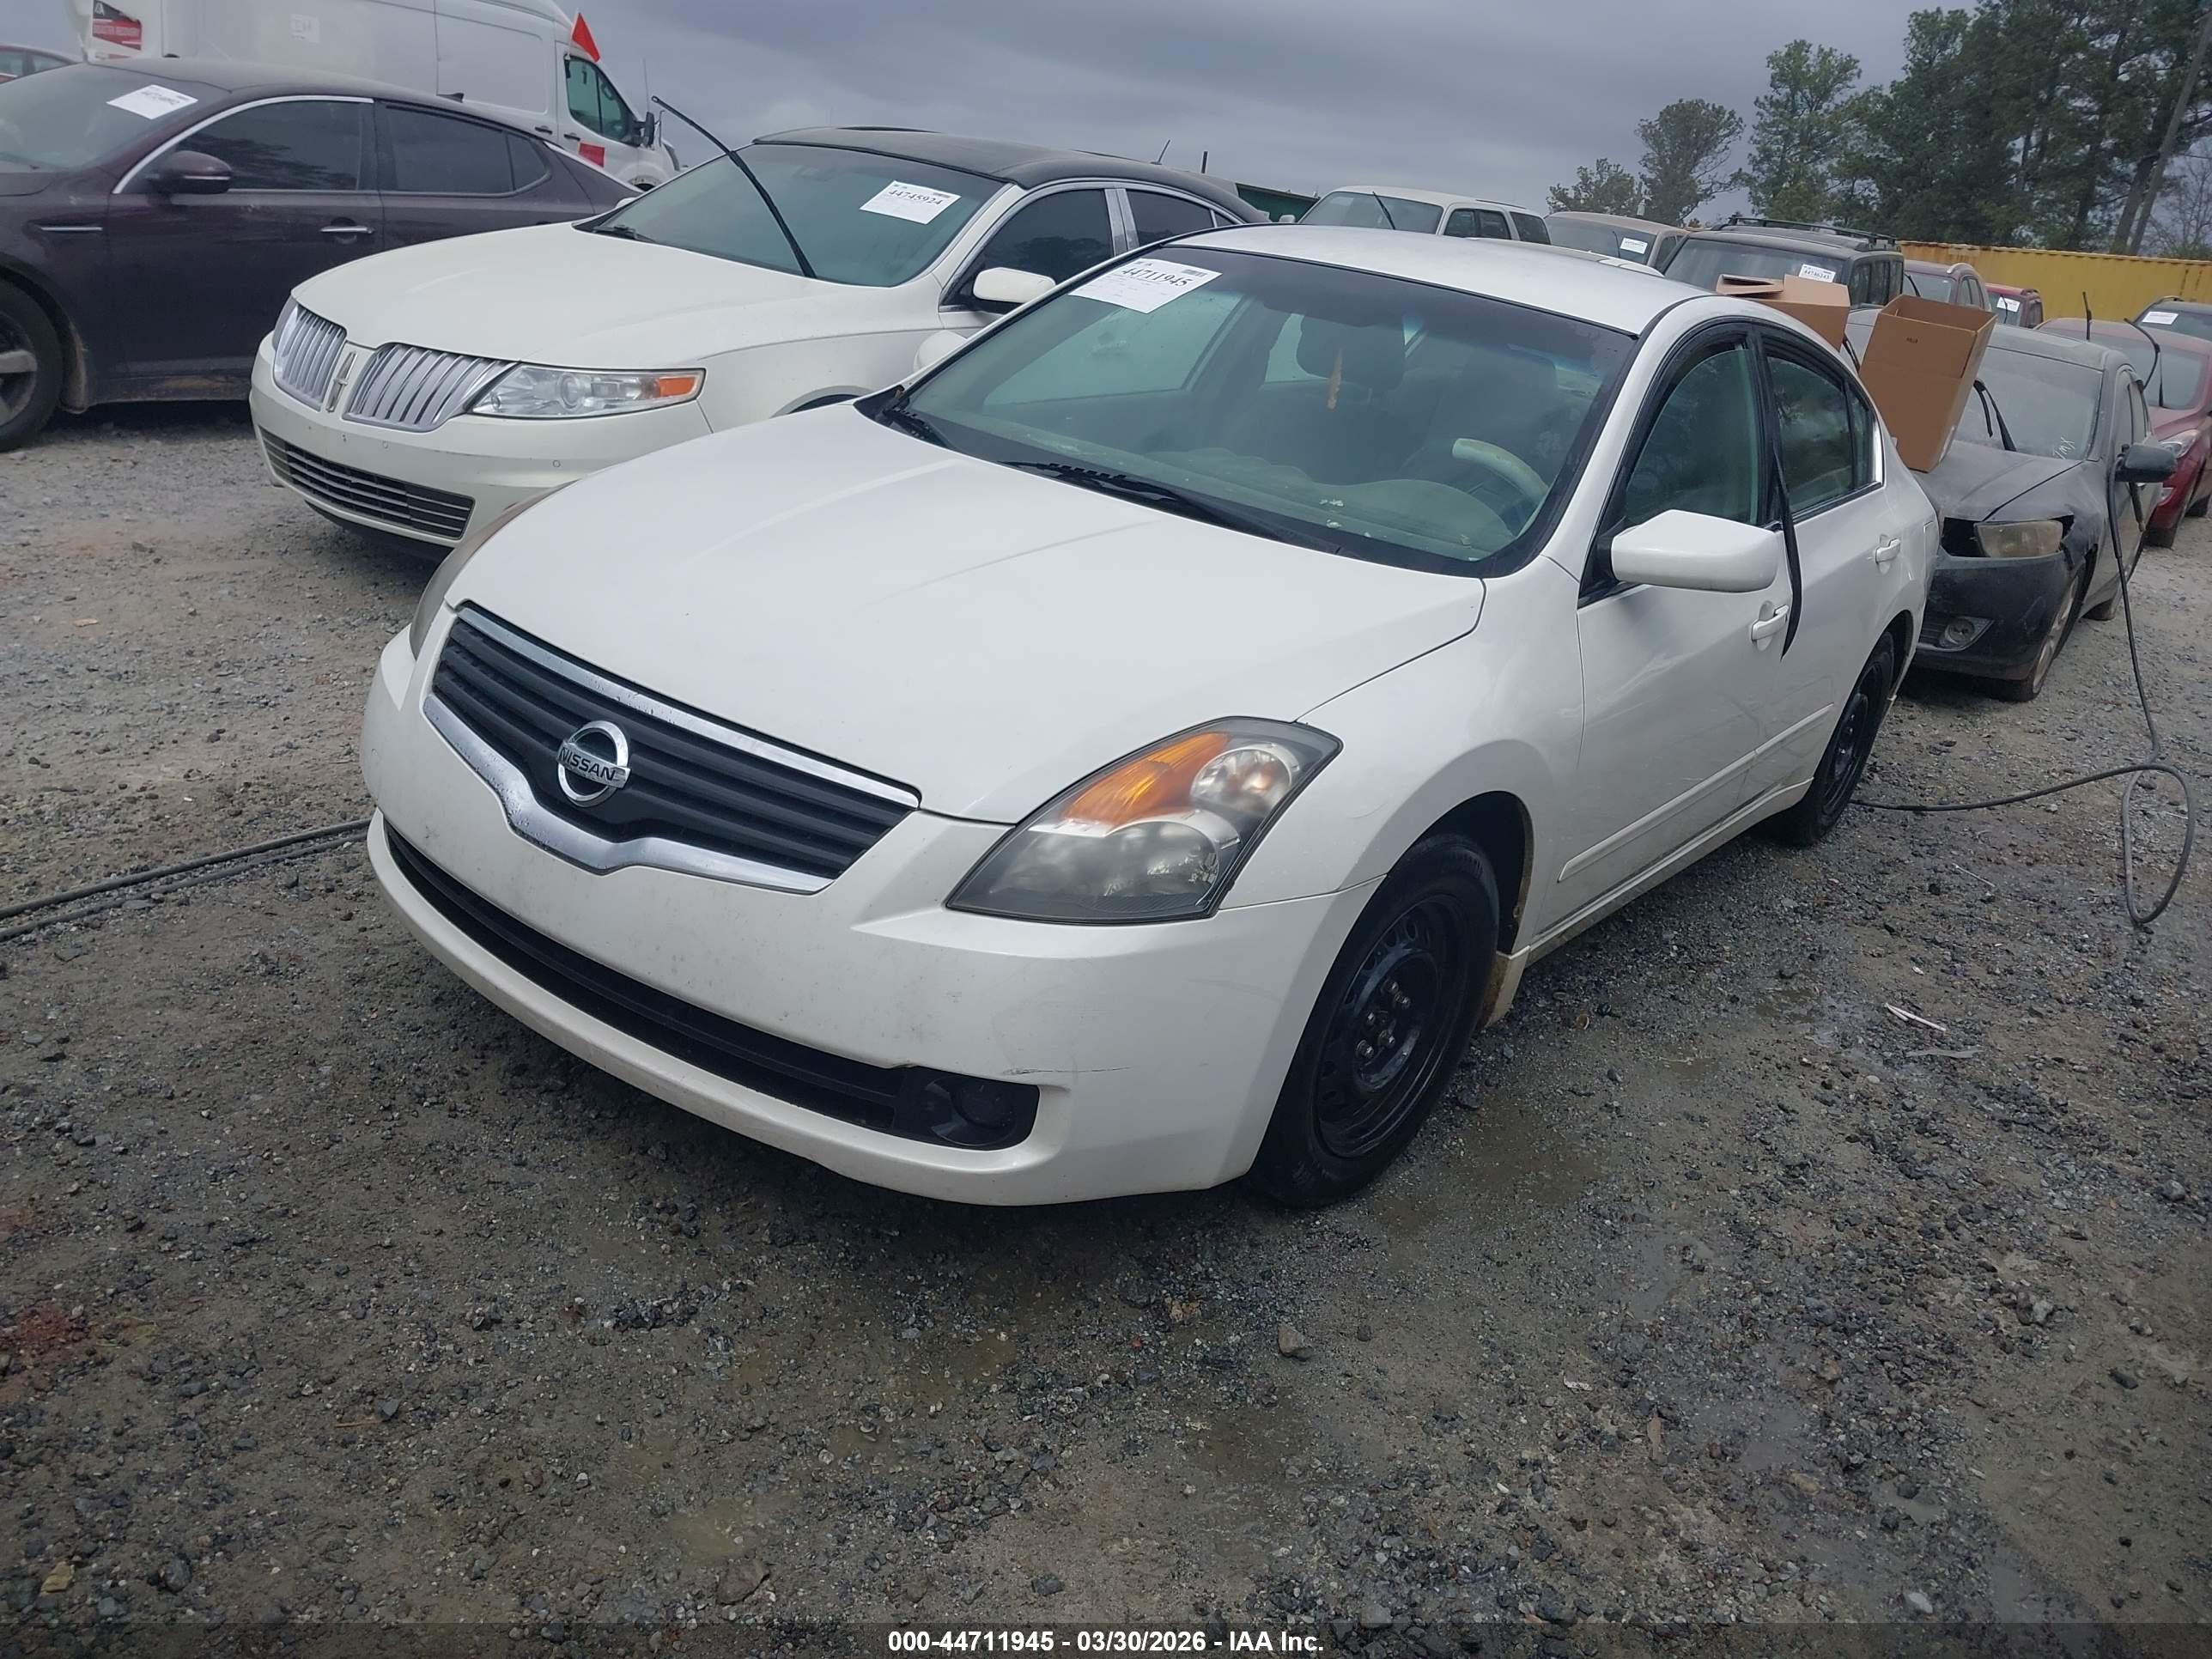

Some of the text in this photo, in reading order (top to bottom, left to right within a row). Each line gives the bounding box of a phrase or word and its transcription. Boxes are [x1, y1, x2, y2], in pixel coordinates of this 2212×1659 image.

[888, 189, 944, 205] 44745924
[1121, 267, 1194, 287] 44711945
[560, 748, 616, 781] NISSAN
